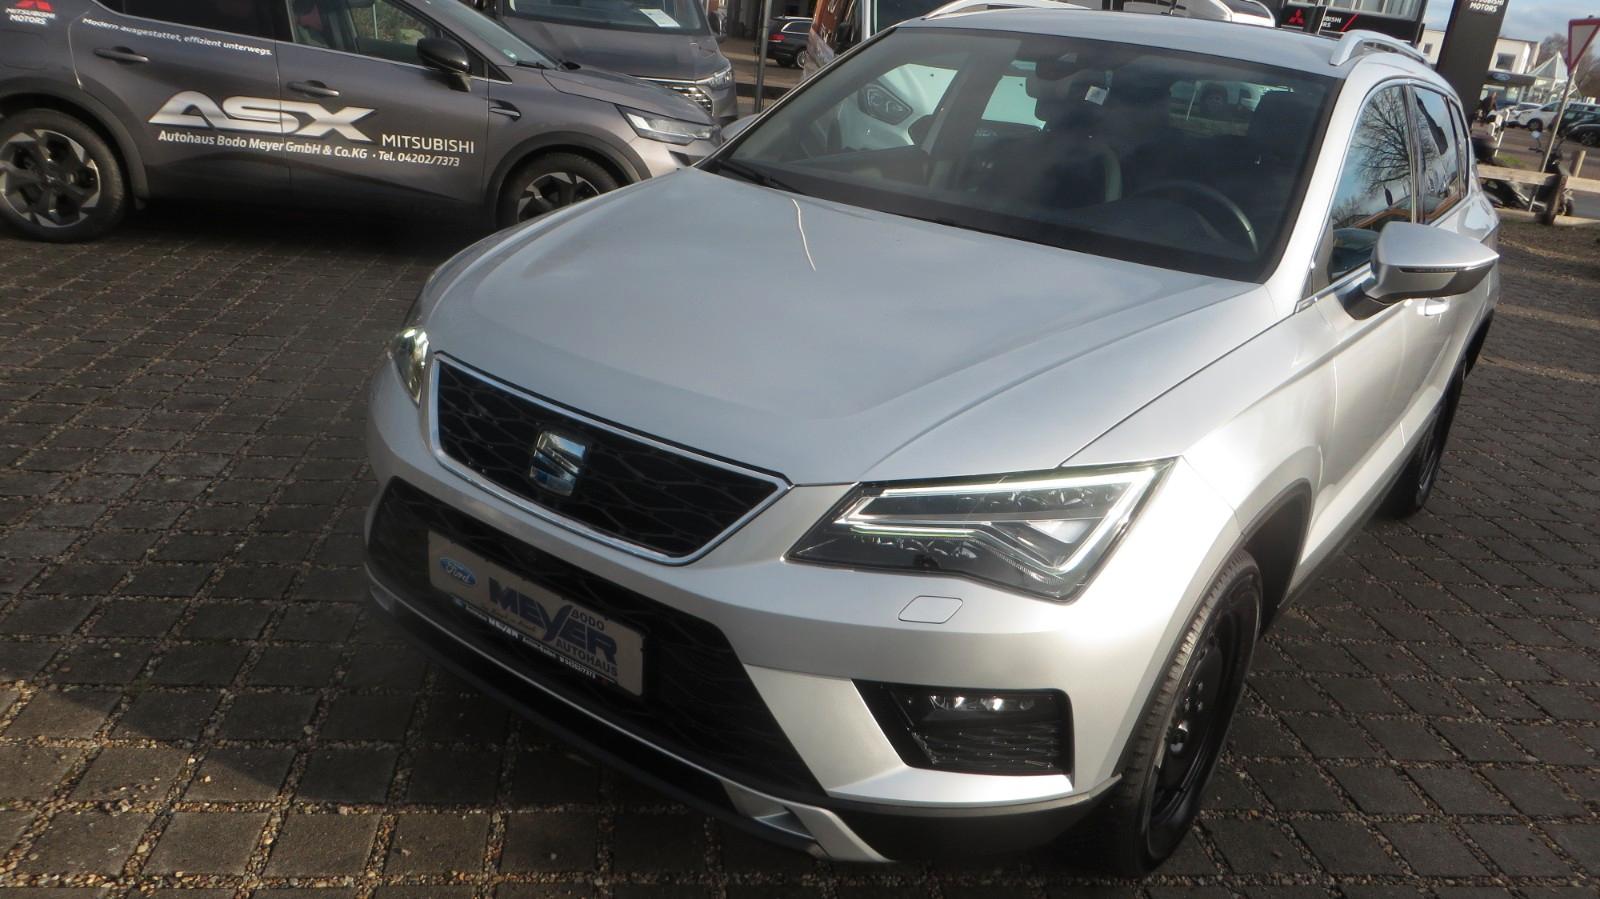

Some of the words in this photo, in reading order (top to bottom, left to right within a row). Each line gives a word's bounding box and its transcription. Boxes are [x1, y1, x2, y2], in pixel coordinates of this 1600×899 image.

[9, 14, 47, 25] MOTORS
[1470, 2, 1498, 12] MOTORS
[82, 17, 119, 30] Modern
[120, 25, 182, 42] ausgestattet,
[184, 35, 222, 47] effizient
[223, 42, 273, 56] unterwegs.
[149, 91, 376, 142] ASX
[158, 130, 215, 145] Autohaus
[216, 135, 247, 148] Bodo
[249, 138, 284, 152] Meyer
[286, 142, 321, 154] GmbH
[322, 145, 332, 154] &
[334, 146, 367, 159] Co.KG
[379, 151, 395, 161] Tel.
[397, 153, 461, 167] 04202/7373
[382, 133, 475, 154] MITSUBISHI
[488, 577, 618, 665] MEYER
[570, 608, 605, 631] BODO
[555, 638, 618, 677] AUTOHAUS
